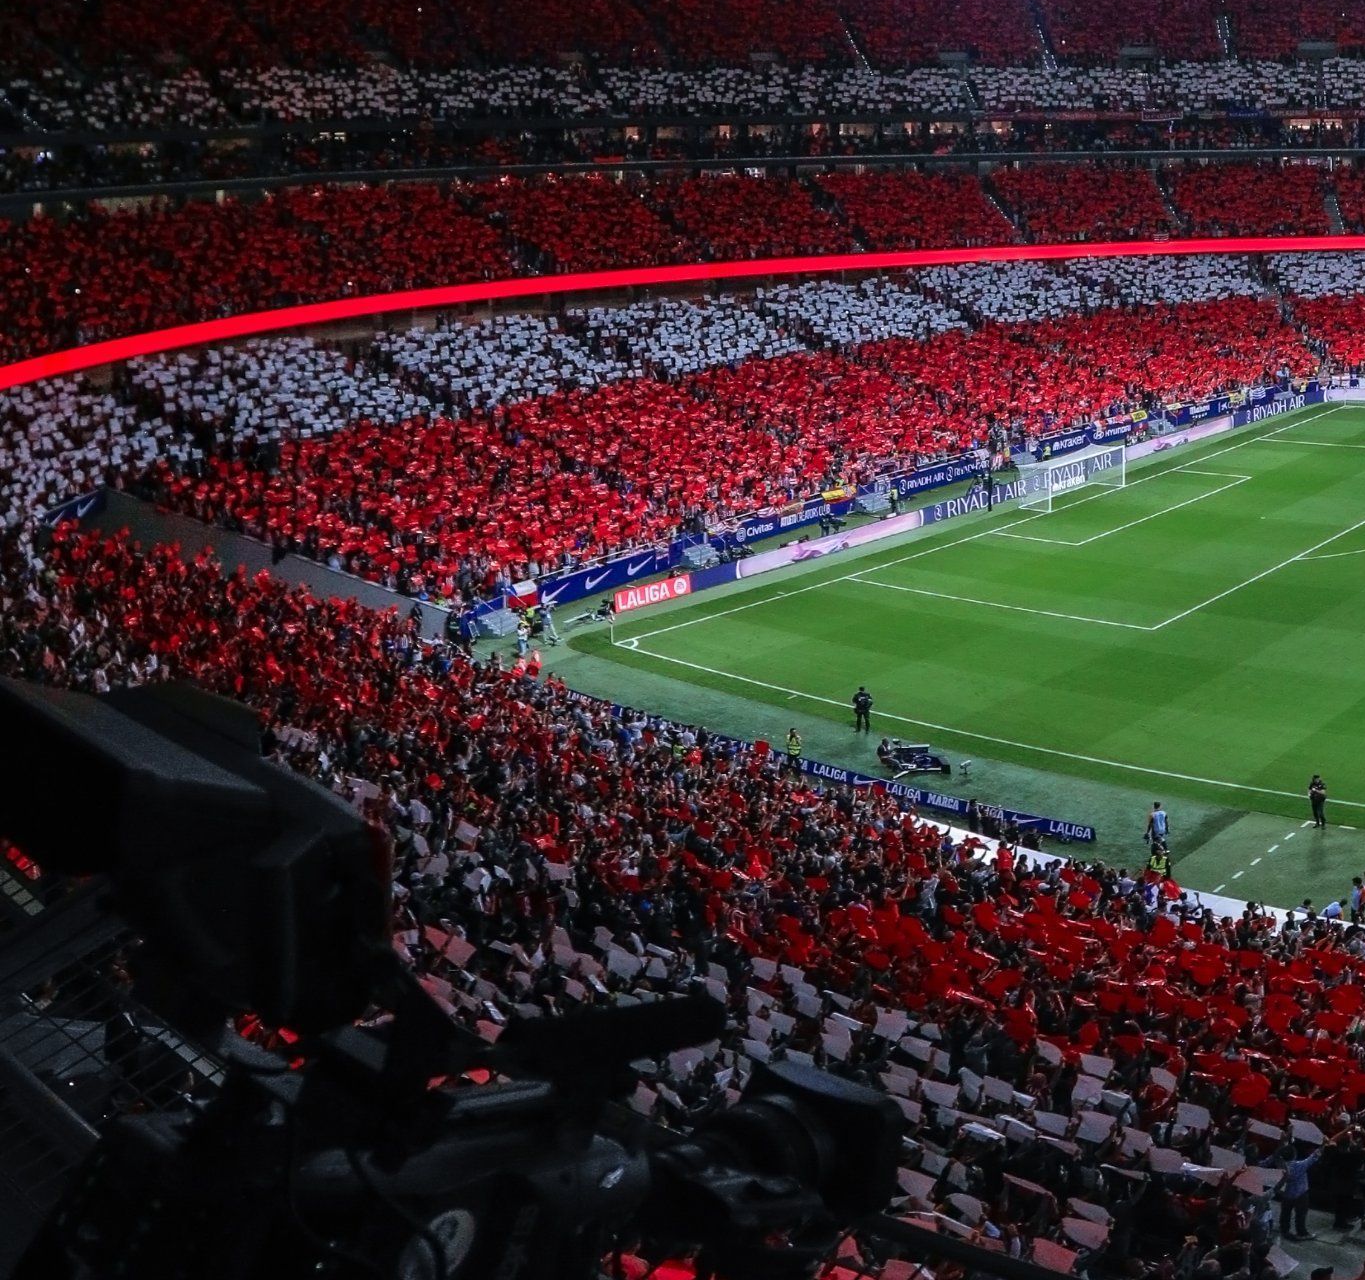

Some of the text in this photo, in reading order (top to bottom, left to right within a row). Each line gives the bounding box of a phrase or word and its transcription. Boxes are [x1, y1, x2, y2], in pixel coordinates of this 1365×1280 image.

[1253, 399, 1288, 422] RIYADH
[1289, 394, 1306, 408] AIR
[1105, 424, 1132, 438] HYUNDAI
[1092, 452, 1113, 471] AIR
[907, 471, 945, 490] RIYADH AIR
[947, 479, 1027, 518] RIYADH AIR
[617, 584, 670, 611] LALIGA
[812, 762, 847, 783] LALIGA
[885, 782, 921, 803] LALIGA
[926, 792, 960, 812] MARCA
[1049, 819, 1092, 840] LALIGA
